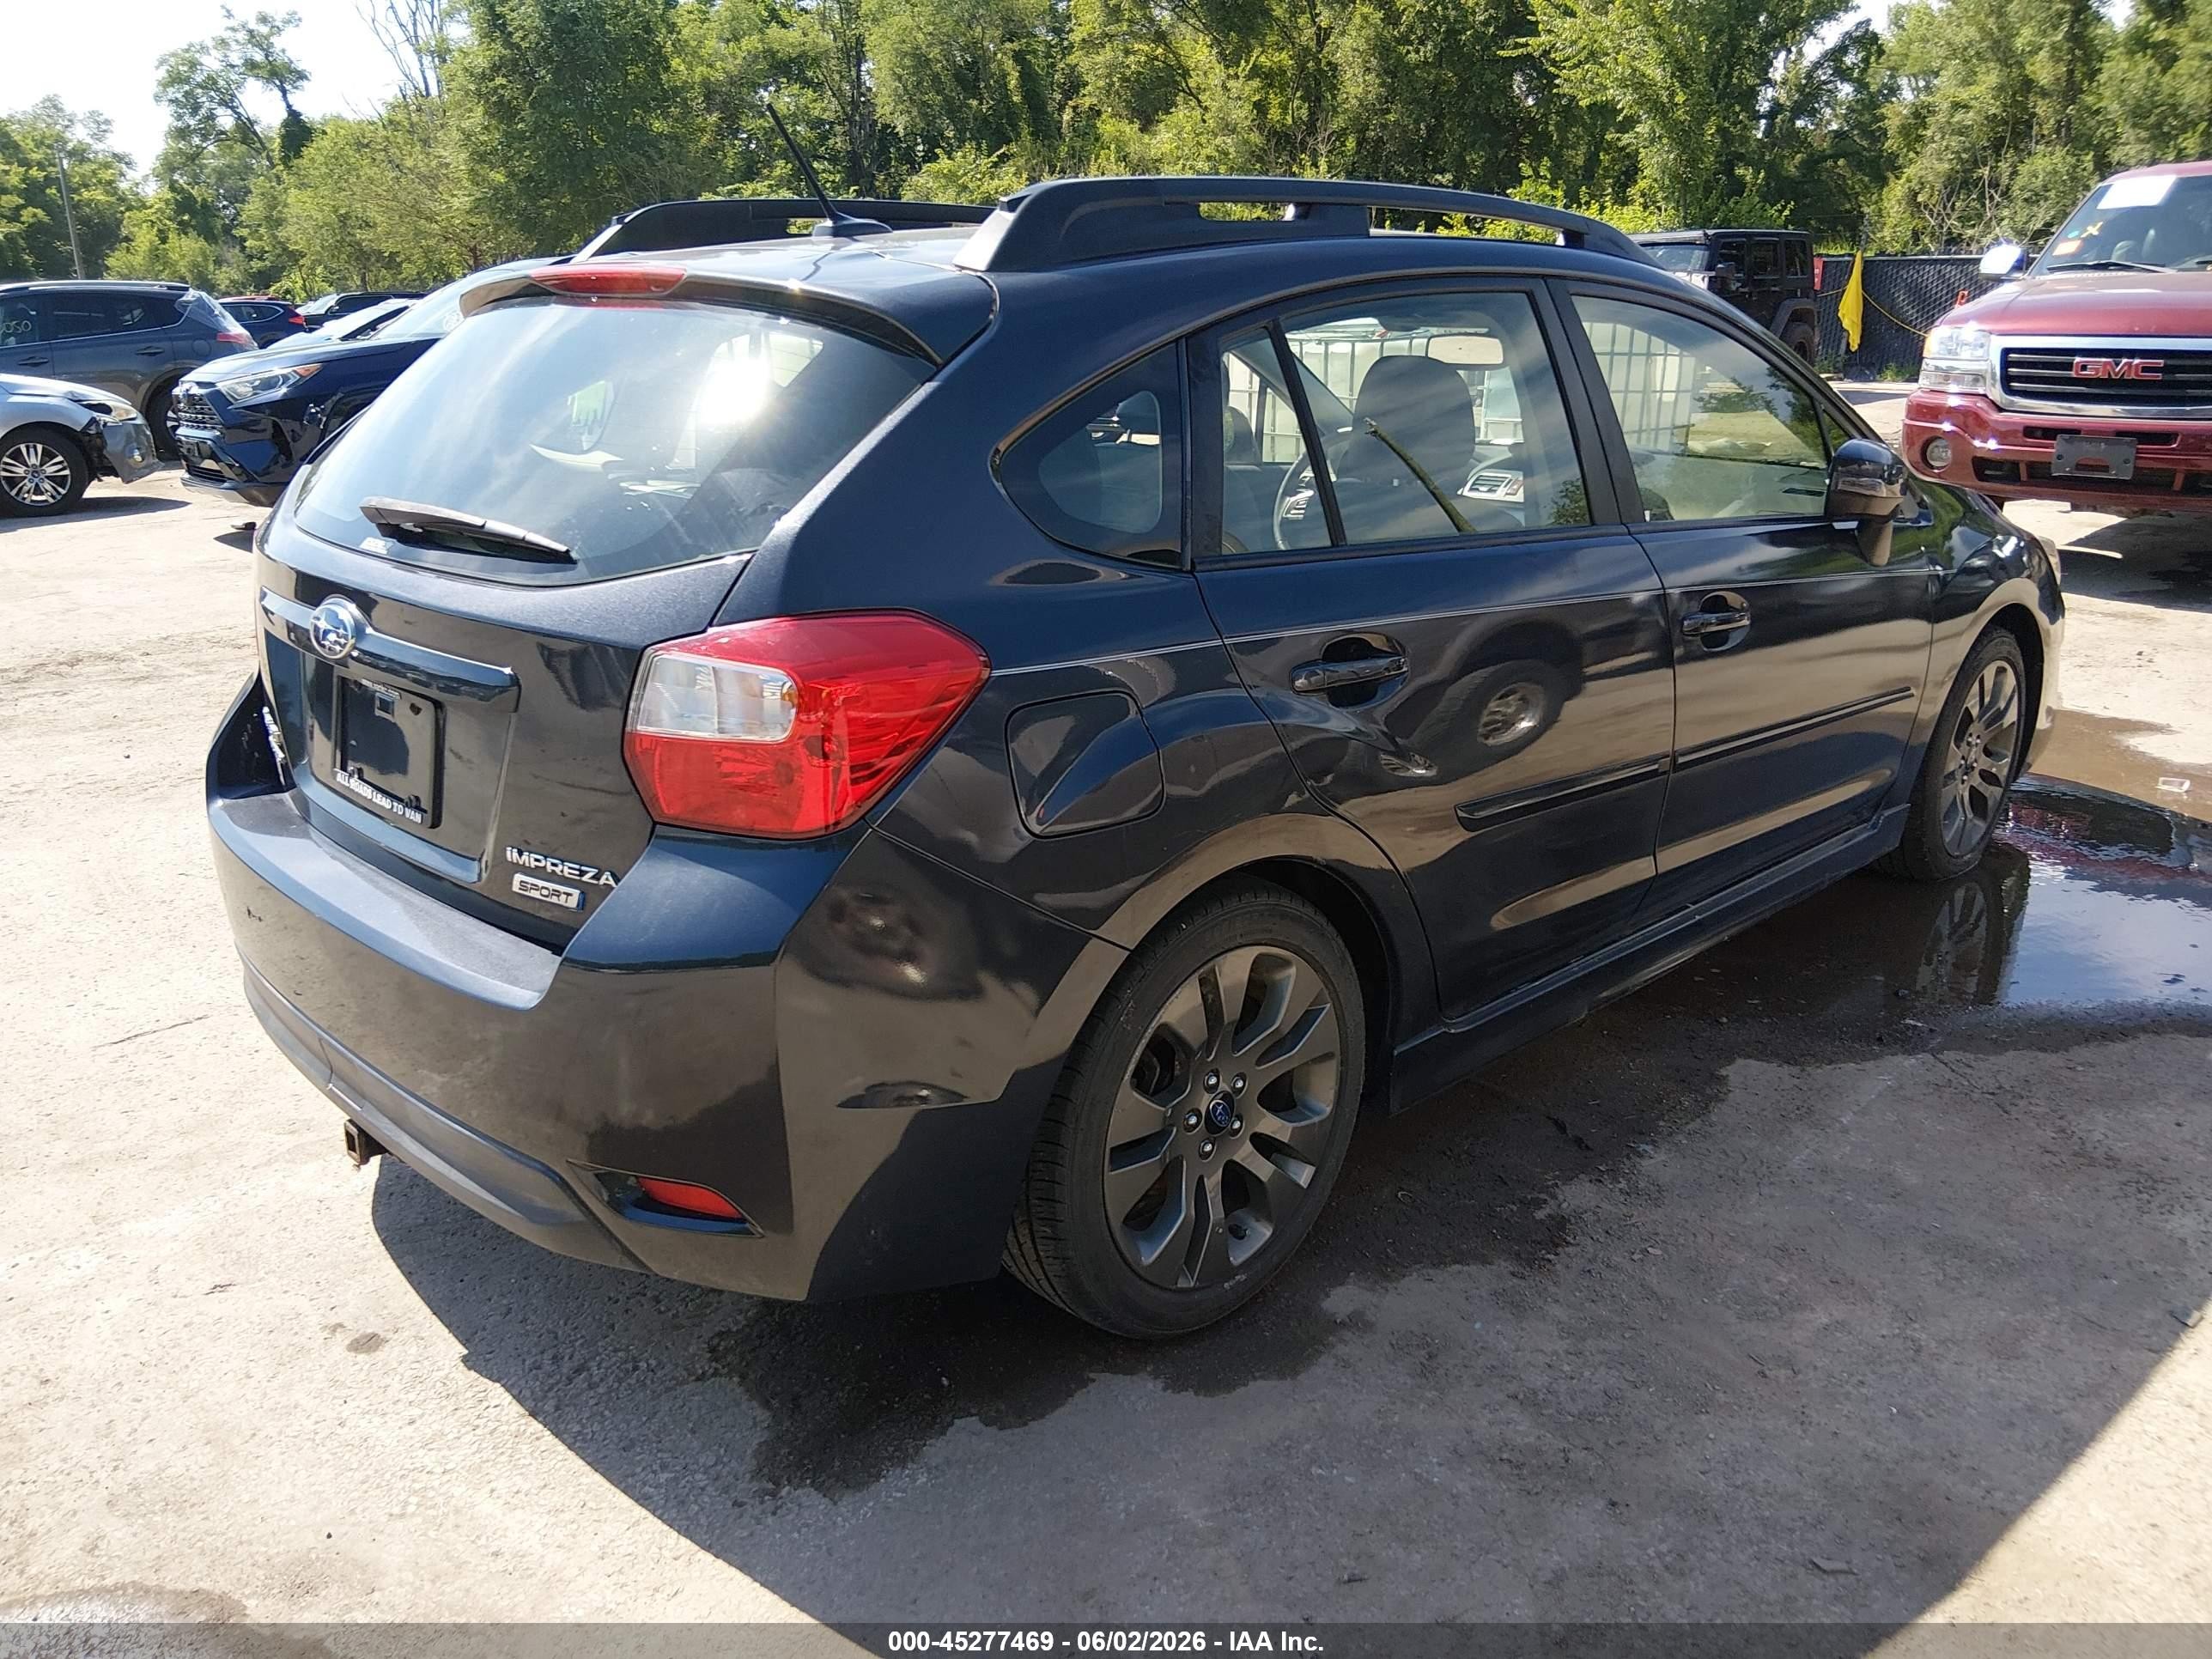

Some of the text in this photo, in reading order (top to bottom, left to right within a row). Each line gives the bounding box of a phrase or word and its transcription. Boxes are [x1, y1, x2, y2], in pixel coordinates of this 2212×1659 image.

[2073, 357, 2165, 380] GMC
[336, 772, 350, 787] ALL
[349, 778, 373, 799] ROADS
[372, 791, 392, 810] LEAD
[506, 846, 620, 888] IMPREZA
[518, 880, 574, 904] SPORT
